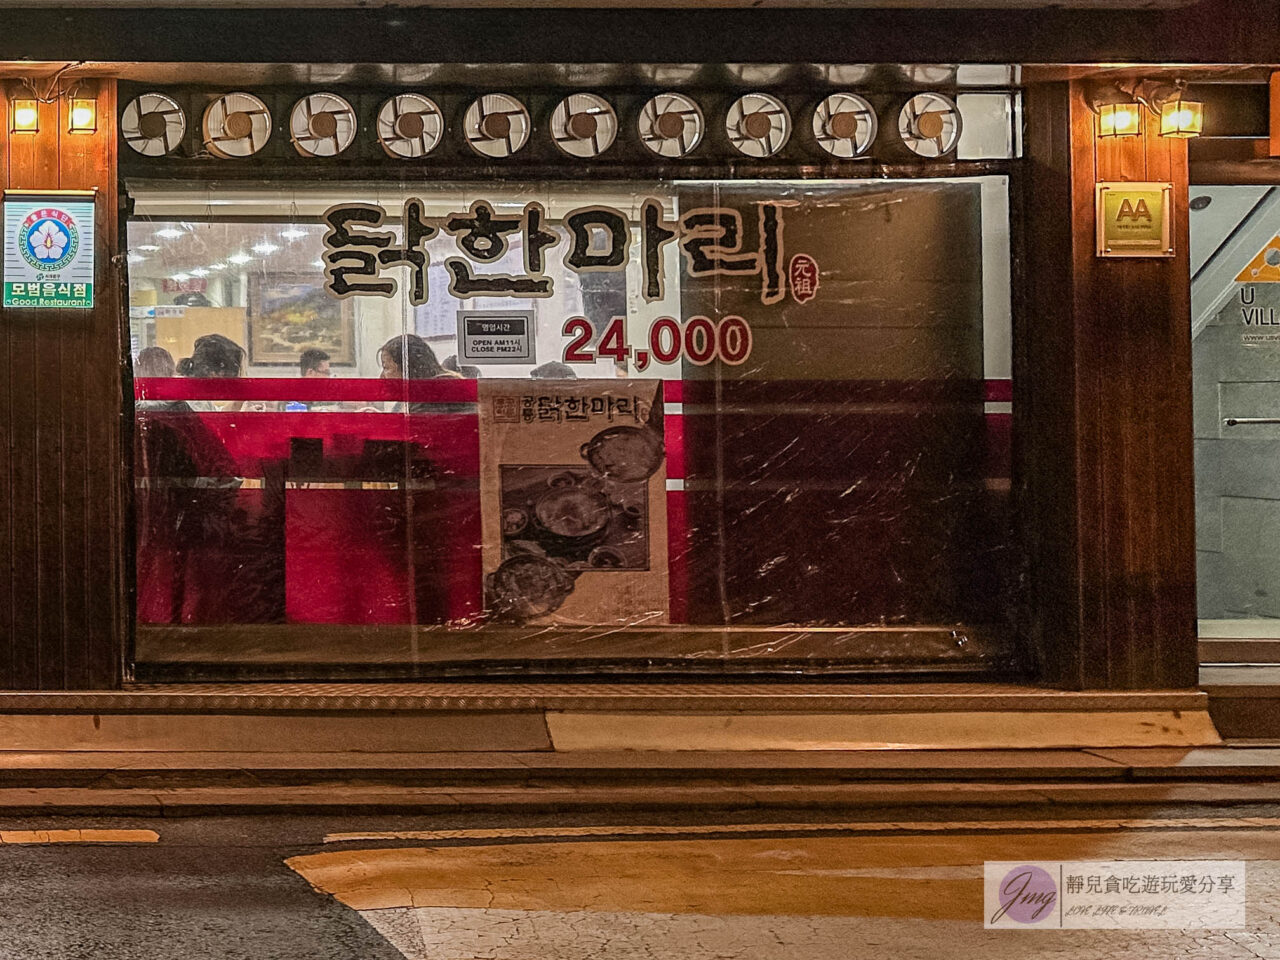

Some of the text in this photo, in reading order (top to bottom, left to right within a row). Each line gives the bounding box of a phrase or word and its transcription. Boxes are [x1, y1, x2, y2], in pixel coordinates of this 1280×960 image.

[322, 198, 785, 306] 닭한마리
[11, 283, 86, 297] 모범음식점
[795, 260, 814, 296] 元祖
[1241, 288, 1254, 305] U
[562, 314, 753, 372] 24,000
[537, 395, 639, 423] 닭한마리
